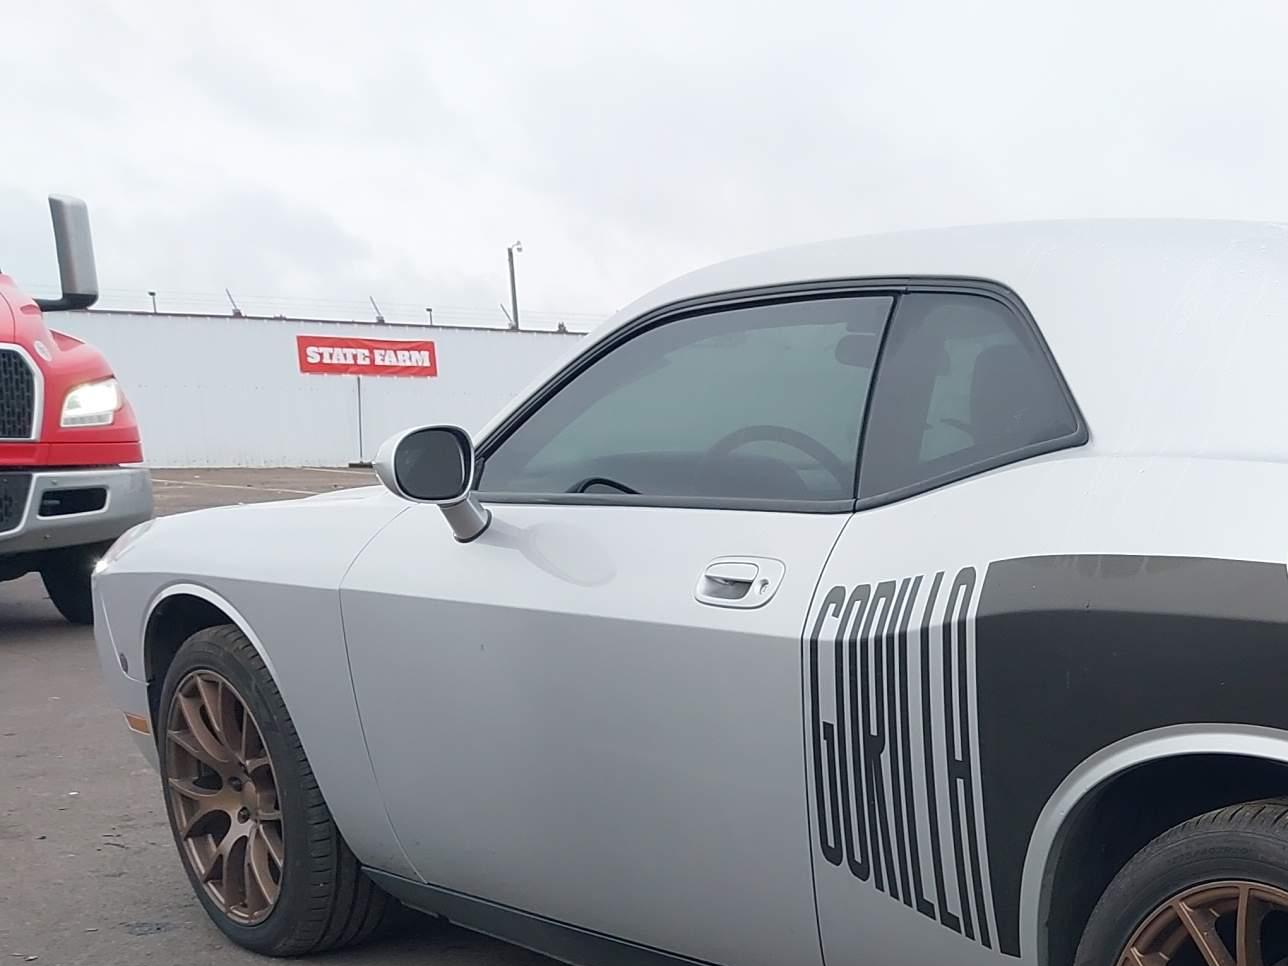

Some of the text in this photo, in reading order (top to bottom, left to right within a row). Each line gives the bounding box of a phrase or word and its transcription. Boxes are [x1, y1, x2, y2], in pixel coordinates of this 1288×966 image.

[306, 346, 430, 366] STATE FARM
[810, 566, 992, 950] GORILLA
